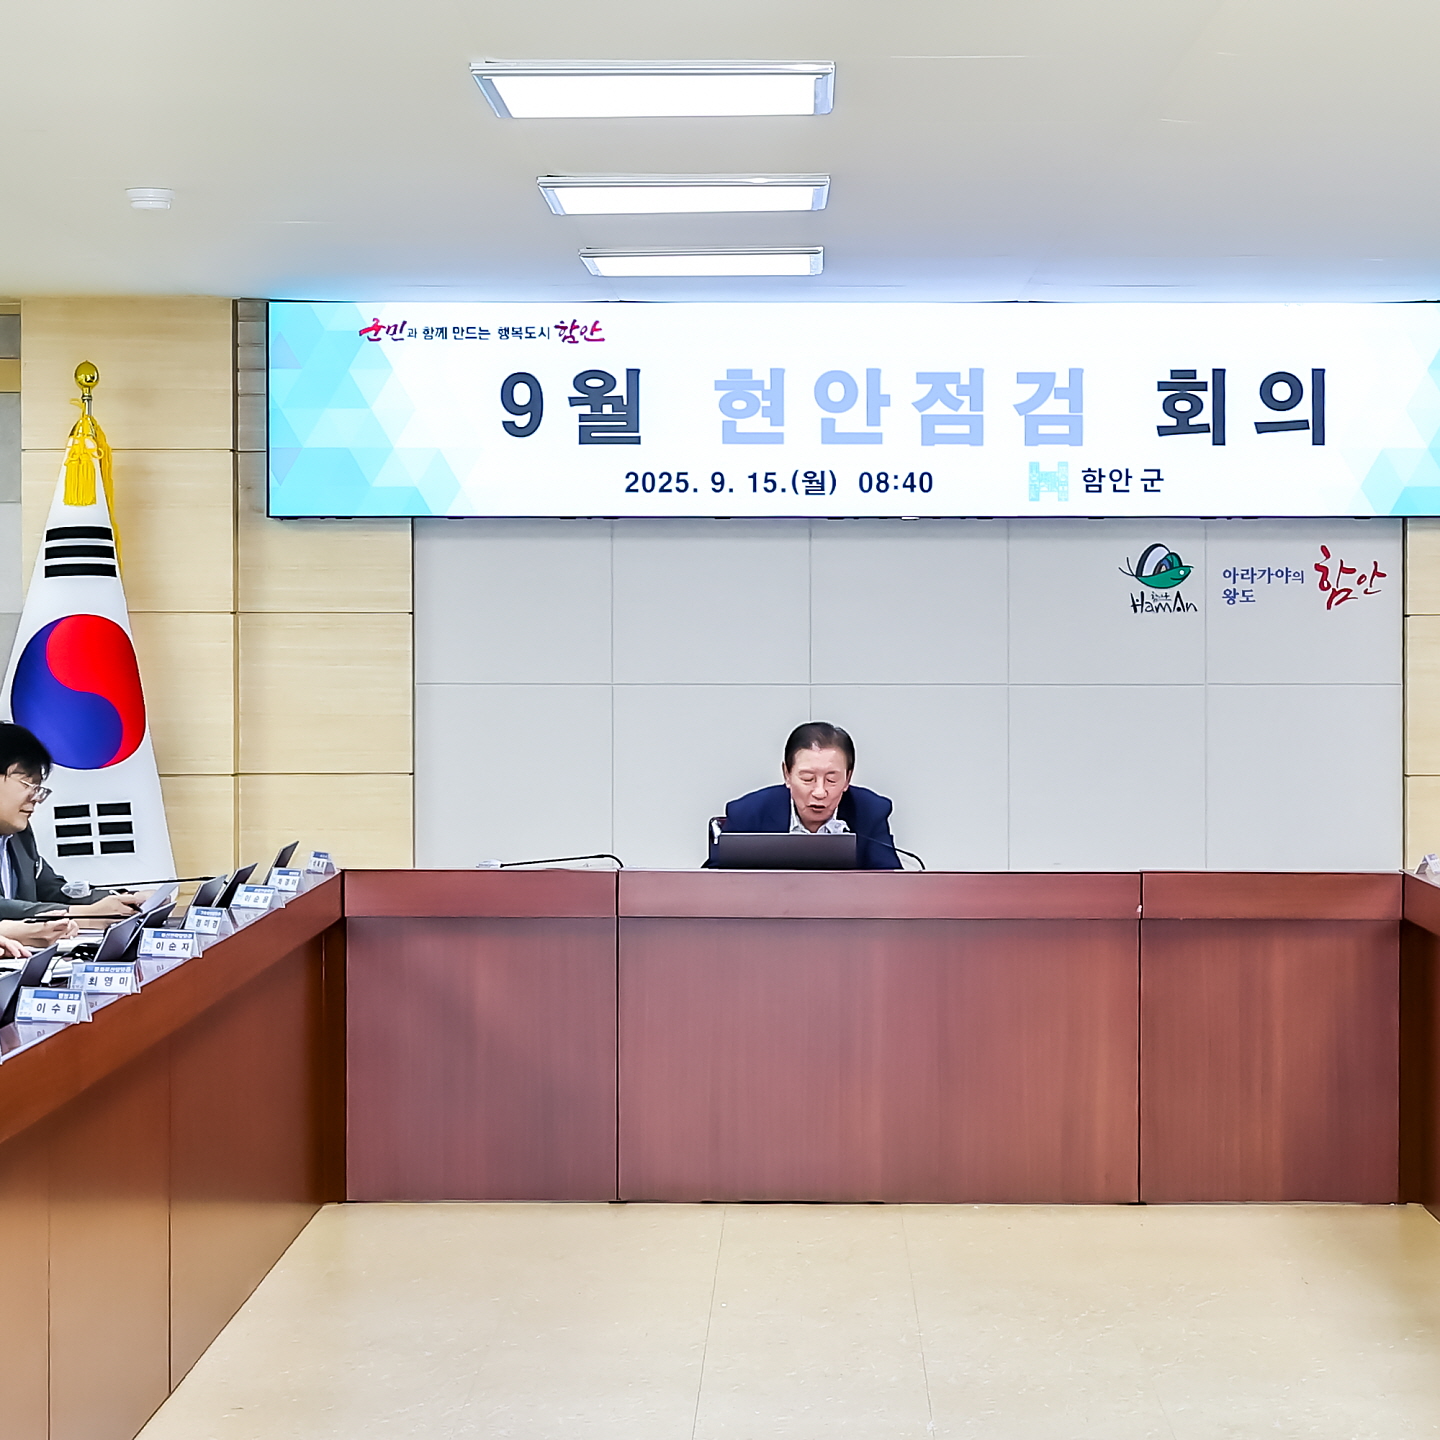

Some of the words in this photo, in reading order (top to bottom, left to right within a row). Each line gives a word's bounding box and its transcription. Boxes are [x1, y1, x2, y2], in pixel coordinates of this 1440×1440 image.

[423, 326, 448, 340] 함께
[453, 326, 491, 340] 만드는
[498, 326, 550, 340] 행복도시
[554, 319, 606, 344] 함안
[500, 367, 643, 446] 9월
[714, 367, 1085, 447] 현안점검
[1156, 367, 1327, 446] 회의
[625, 471, 698, 494] 2025.
[710, 471, 734, 494] 9.
[747, 469, 838, 497] 15.(월)
[859, 471, 934, 494] 08:40
[1222, 567, 1304, 584] 아라가야의
[1314, 545, 1387, 610] 함안
[1130, 590, 1198, 614] HamAn
[1222, 588, 1256, 605] 왕도
[36, 1002, 77, 1015] 이수태
